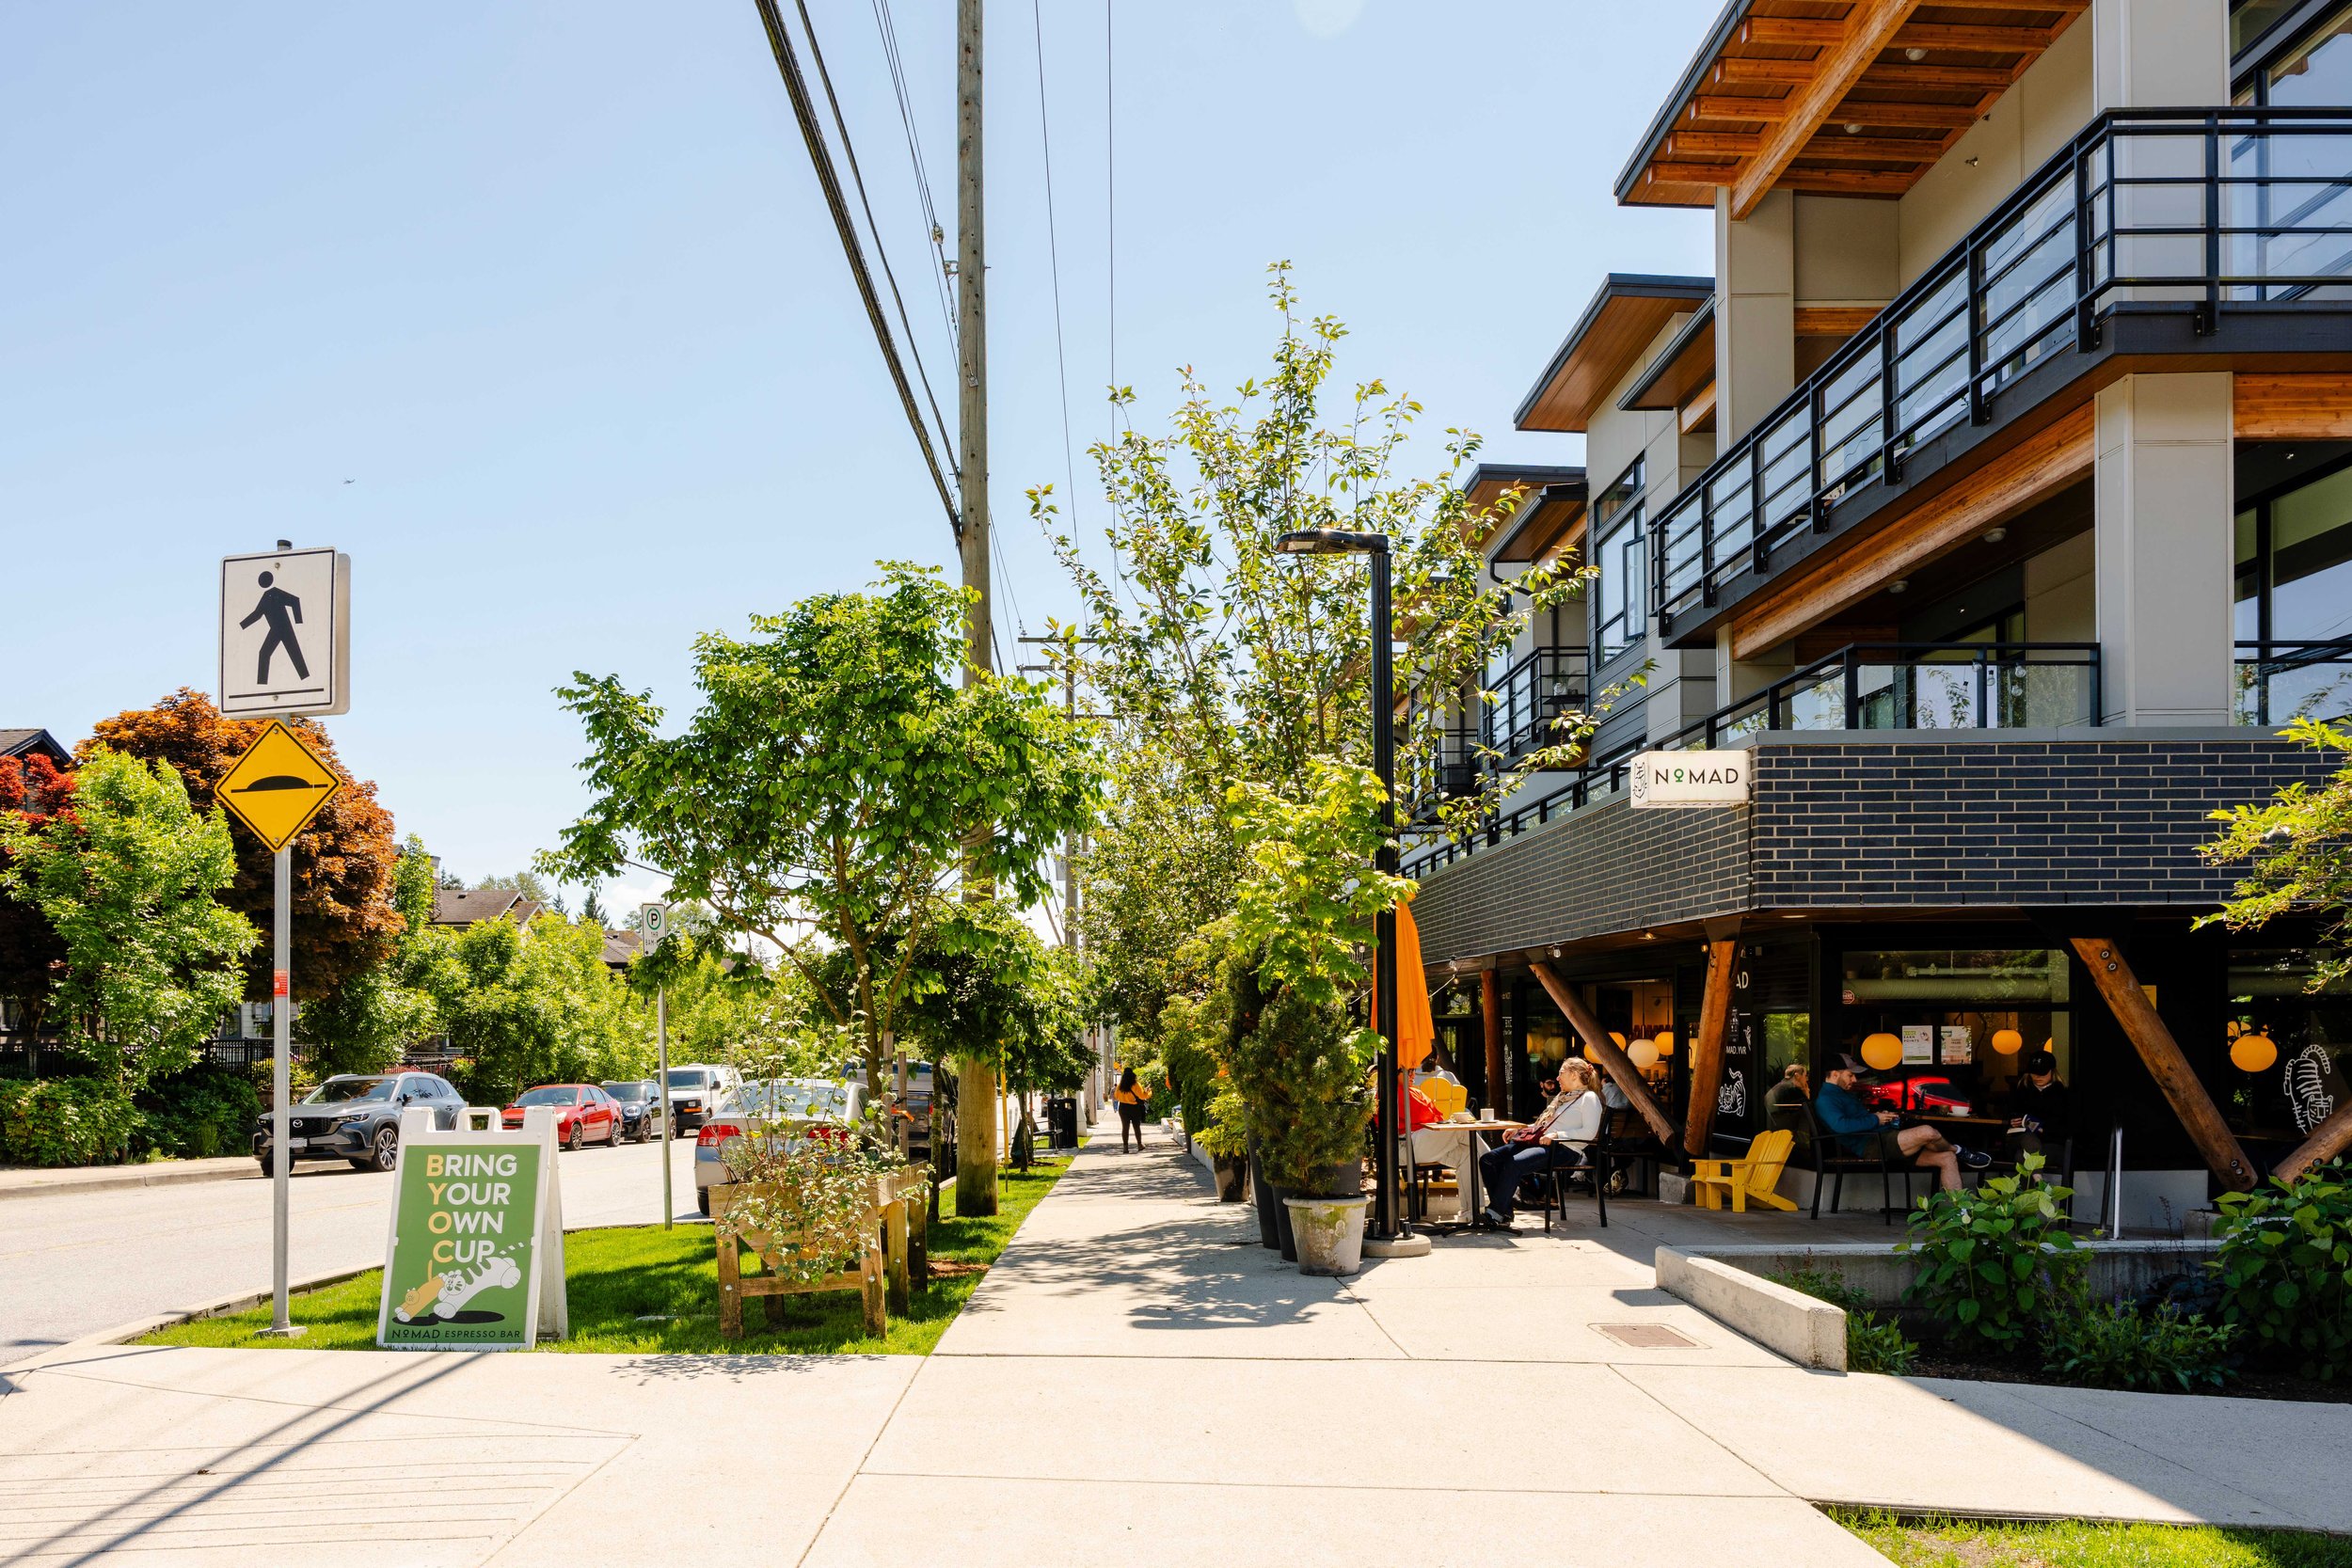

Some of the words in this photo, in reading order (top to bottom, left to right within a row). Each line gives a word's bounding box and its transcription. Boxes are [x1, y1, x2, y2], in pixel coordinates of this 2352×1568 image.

[1655, 768, 1739, 784] NOMAD
[651, 913, 658, 925] P
[426, 1153, 517, 1177] BRING
[427, 1182, 511, 1205] YOUR
[427, 1211, 504, 1234] OWN
[432, 1240, 496, 1263] CUP
[391, 1328, 440, 1339] NOMAD
[444, 1330, 497, 1338] ESPRESSO
[501, 1330, 520, 1338] BAR
